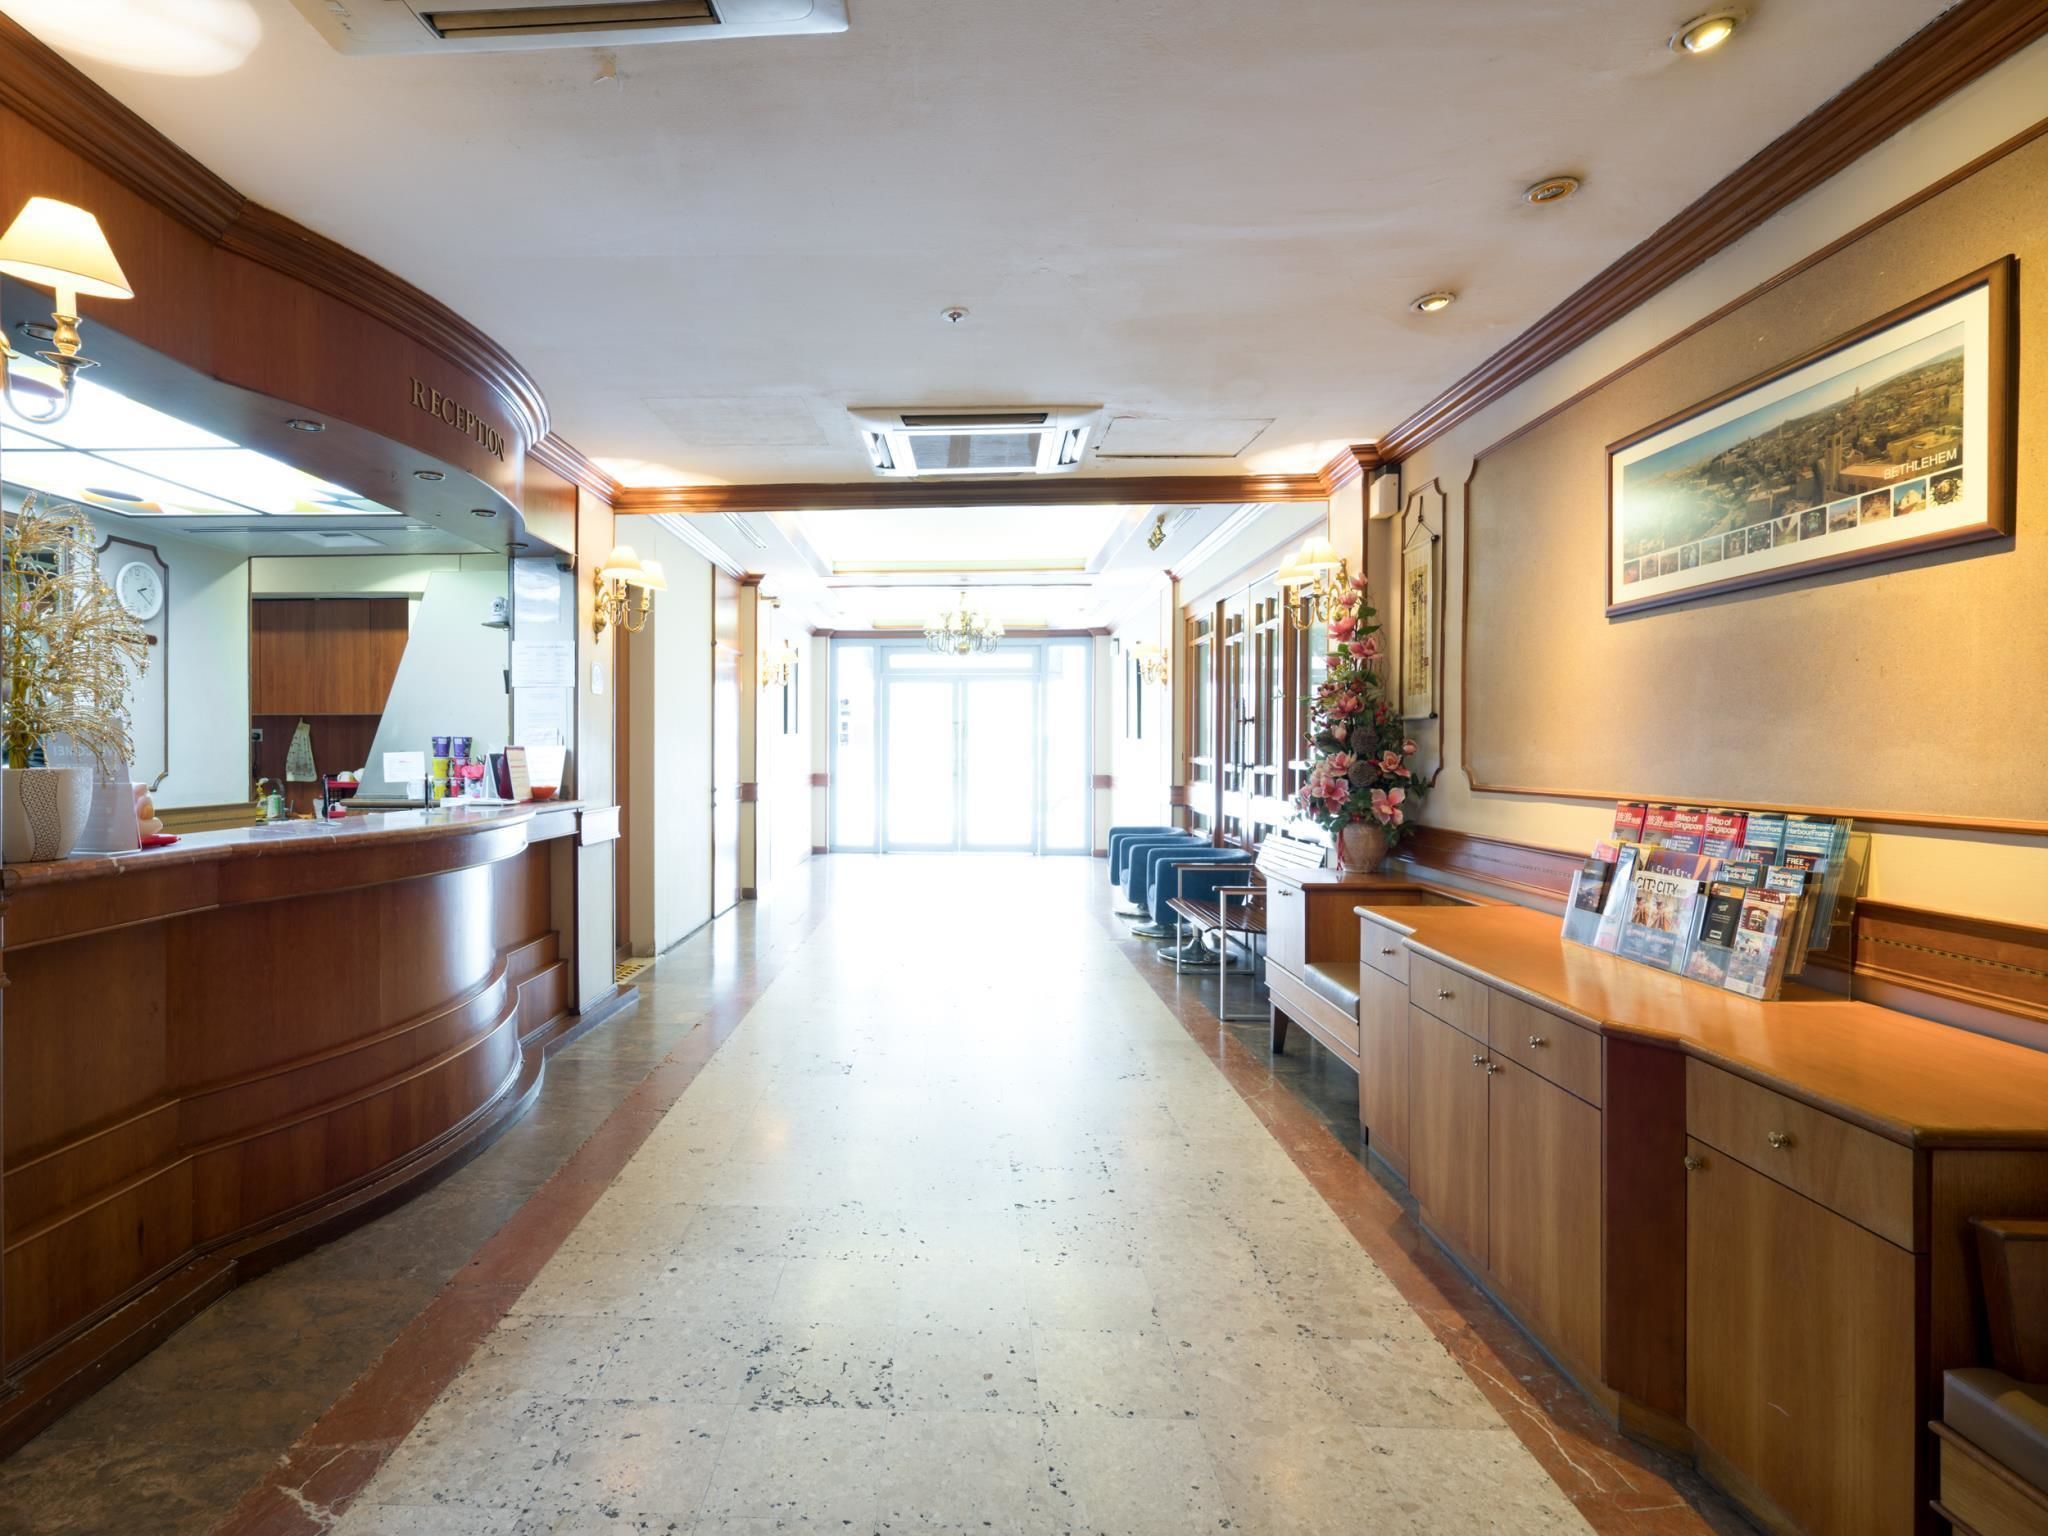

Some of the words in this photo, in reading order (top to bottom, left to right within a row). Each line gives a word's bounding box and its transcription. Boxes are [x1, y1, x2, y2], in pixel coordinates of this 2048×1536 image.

[409, 376, 505, 462] RECEPTION
[1883, 447, 1957, 480] BETHLEHEM
[1673, 820, 1704, 832] Singapore
[1705, 824, 1738, 836] Singapore
[1786, 857, 1805, 866] FREE
[1656, 880, 1679, 894] CITY
